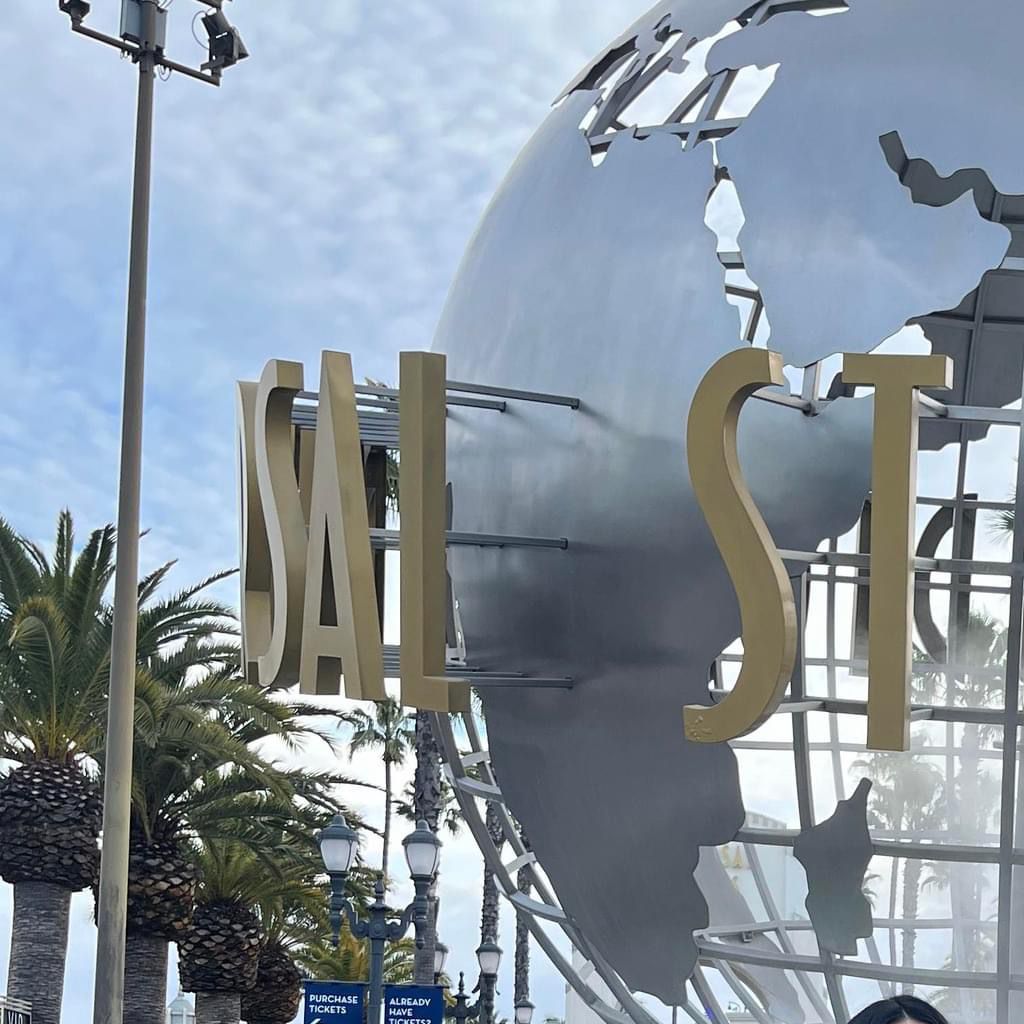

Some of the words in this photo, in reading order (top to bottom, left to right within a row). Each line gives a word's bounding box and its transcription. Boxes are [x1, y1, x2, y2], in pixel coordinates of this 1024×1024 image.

[309, 994, 358, 1004] PURCHASE
[389, 998, 431, 1006] ALREADY
[309, 1004, 347, 1014] TICKETS
[389, 1008, 413, 1017] HAVE
